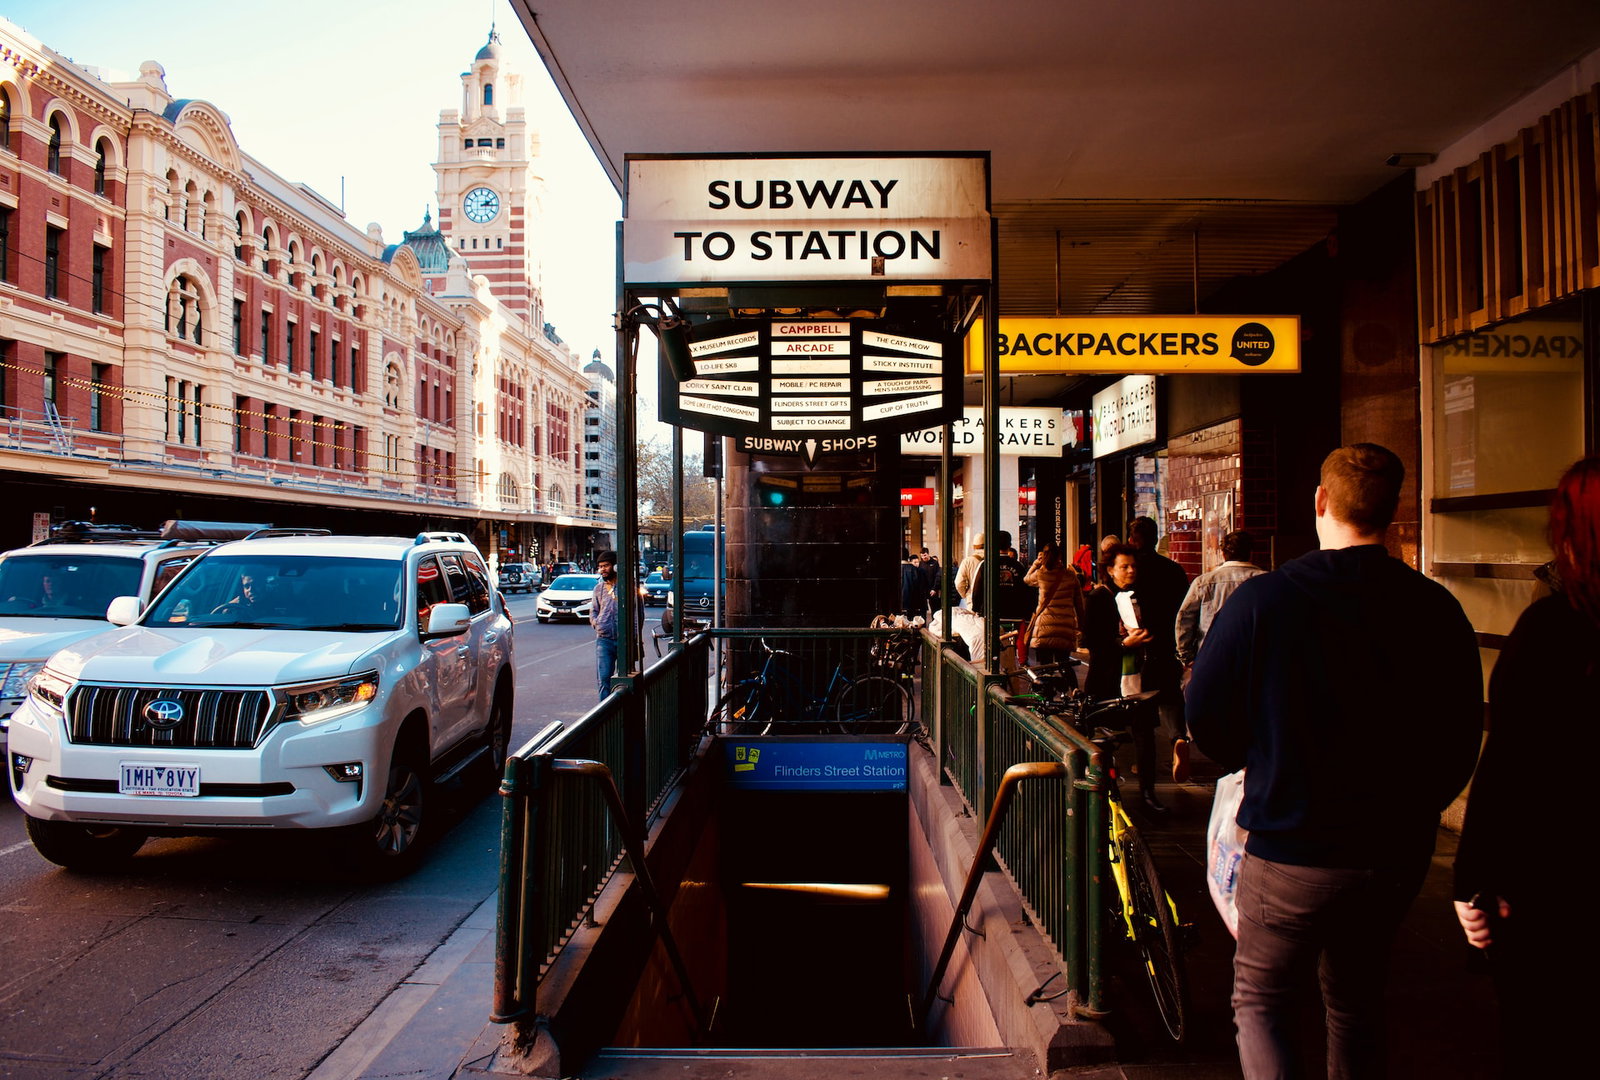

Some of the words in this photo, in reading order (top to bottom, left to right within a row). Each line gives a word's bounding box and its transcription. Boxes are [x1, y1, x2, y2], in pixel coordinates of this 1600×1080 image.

[708, 179, 899, 210] SUBWAY
[674, 230, 735, 261] TO
[750, 230, 941, 261] STATION
[780, 325, 841, 335] CAMPBELL
[699, 341, 726, 351] MUSEUM
[727, 335, 757, 345] RECORDS
[786, 343, 834, 353] ARCADE
[890, 339, 908, 347] CATS
[908, 342, 930, 351] MEOW
[998, 332, 1219, 356] BACKPACKERS
[1236, 341, 1270, 349] UNITED
[1103, 381, 1155, 417] BACKPACKERS
[722, 406, 756, 417] CONSIGNMENT
[880, 406, 894, 414] CUP
[905, 400, 929, 409] TRUTH
[1104, 416, 1126, 438] WORLD
[1128, 404, 1154, 430] TRAVEL
[744, 436, 802, 452] SUBWAY
[821, 435, 877, 452] SHOPS
[983, 432, 1055, 446] RAVEL
[1054, 496, 1062, 547] CURRENCY
[878, 751, 906, 759] METRO
[774, 765, 821, 777] Flinders
[824, 765, 860, 777] Street
[863, 765, 905, 777] Station
